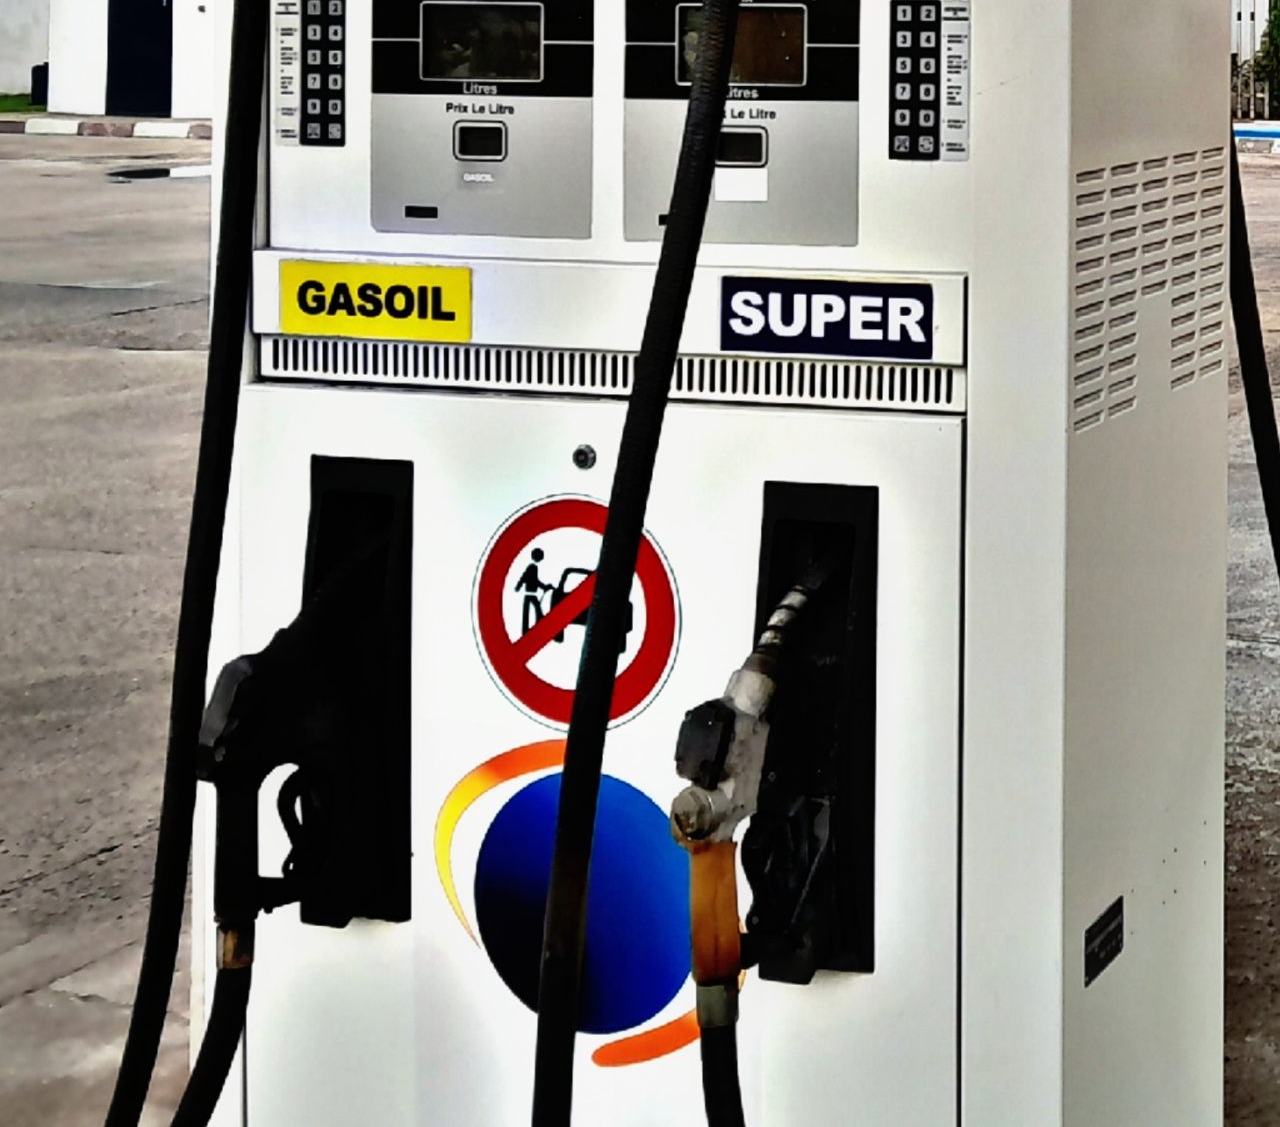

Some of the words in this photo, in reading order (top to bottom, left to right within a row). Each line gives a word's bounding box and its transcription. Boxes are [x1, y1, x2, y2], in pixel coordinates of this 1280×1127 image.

[463, 81, 497, 95] Litres
[446, 102, 468, 113] Prix
[472, 103, 485, 114] Le
[489, 103, 515, 115] Litre
[731, 109, 745, 119] Le
[749, 109, 777, 120] Litre
[297, 280, 456, 321] GASOIL
[727, 291, 926, 344] SUPER
